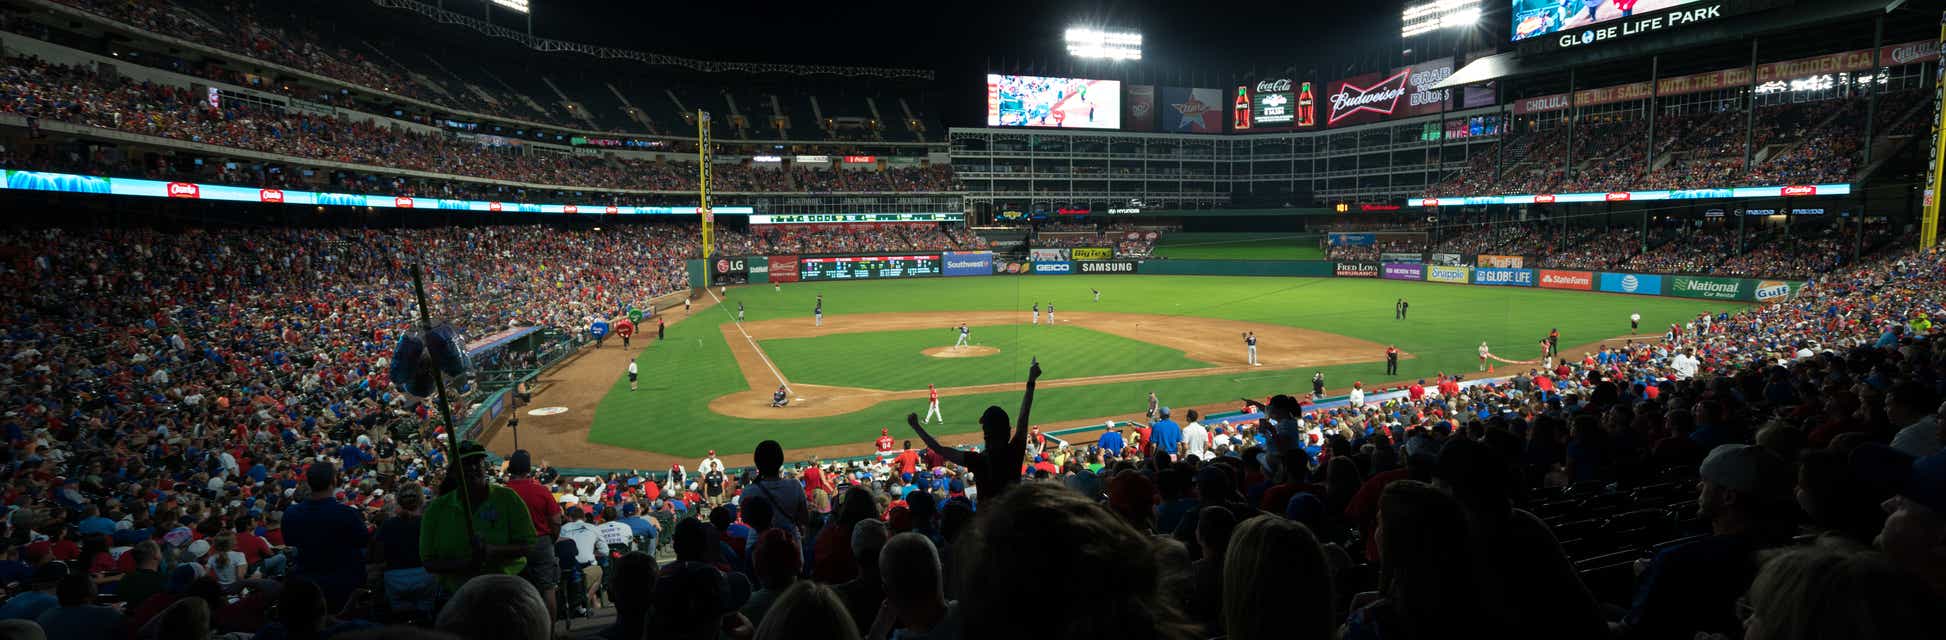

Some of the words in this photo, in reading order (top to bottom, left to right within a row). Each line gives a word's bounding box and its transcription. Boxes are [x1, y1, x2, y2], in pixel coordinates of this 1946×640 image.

[1559, 26, 1618, 47] GLOBE
[1623, 17, 1663, 36] LIFE
[1668, 5, 1721, 26] PARK
[1330, 87, 1405, 110] Budweiser
[730, 260, 743, 271] LG
[1036, 263, 1070, 271] GEICO
[1082, 263, 1133, 272] SAMSUNG
[1486, 271, 1513, 282] GLOBE
[1515, 271, 1531, 283] LIFE
[1687, 279, 1739, 292] National
[1757, 286, 1788, 298] Gulf
